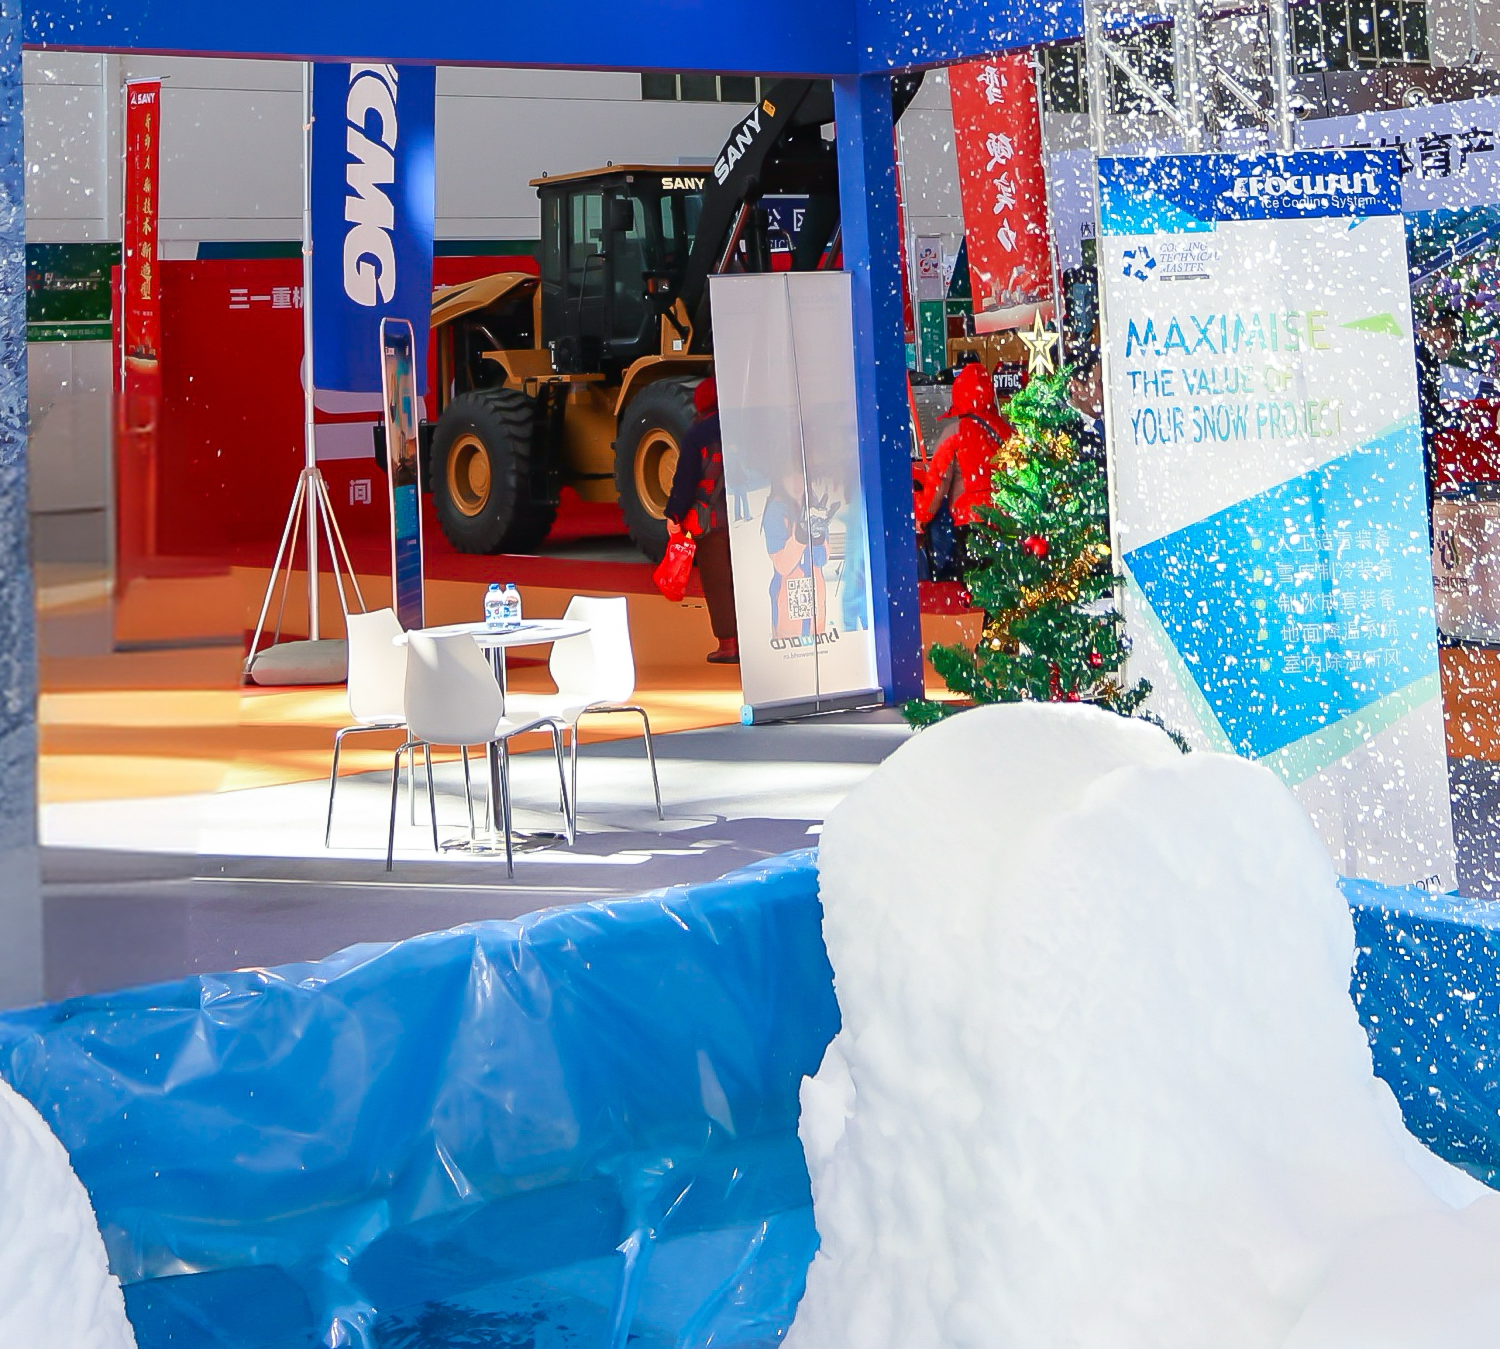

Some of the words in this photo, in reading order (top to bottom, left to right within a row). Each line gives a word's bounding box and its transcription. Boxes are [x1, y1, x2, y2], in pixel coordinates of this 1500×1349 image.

[714, 107, 761, 186] SANY
[661, 177, 705, 190] SANY
[1331, 194, 1377, 209] System
[1126, 309, 1331, 358] MAXIMISE
[1127, 369, 1175, 398] THE
[1182, 364, 1254, 396] VALUE
[1264, 363, 1294, 394] OF
[1131, 404, 1184, 445] YOUR
[1192, 402, 1251, 444] SNOW
[1257, 399, 1343, 439] PROJECT
